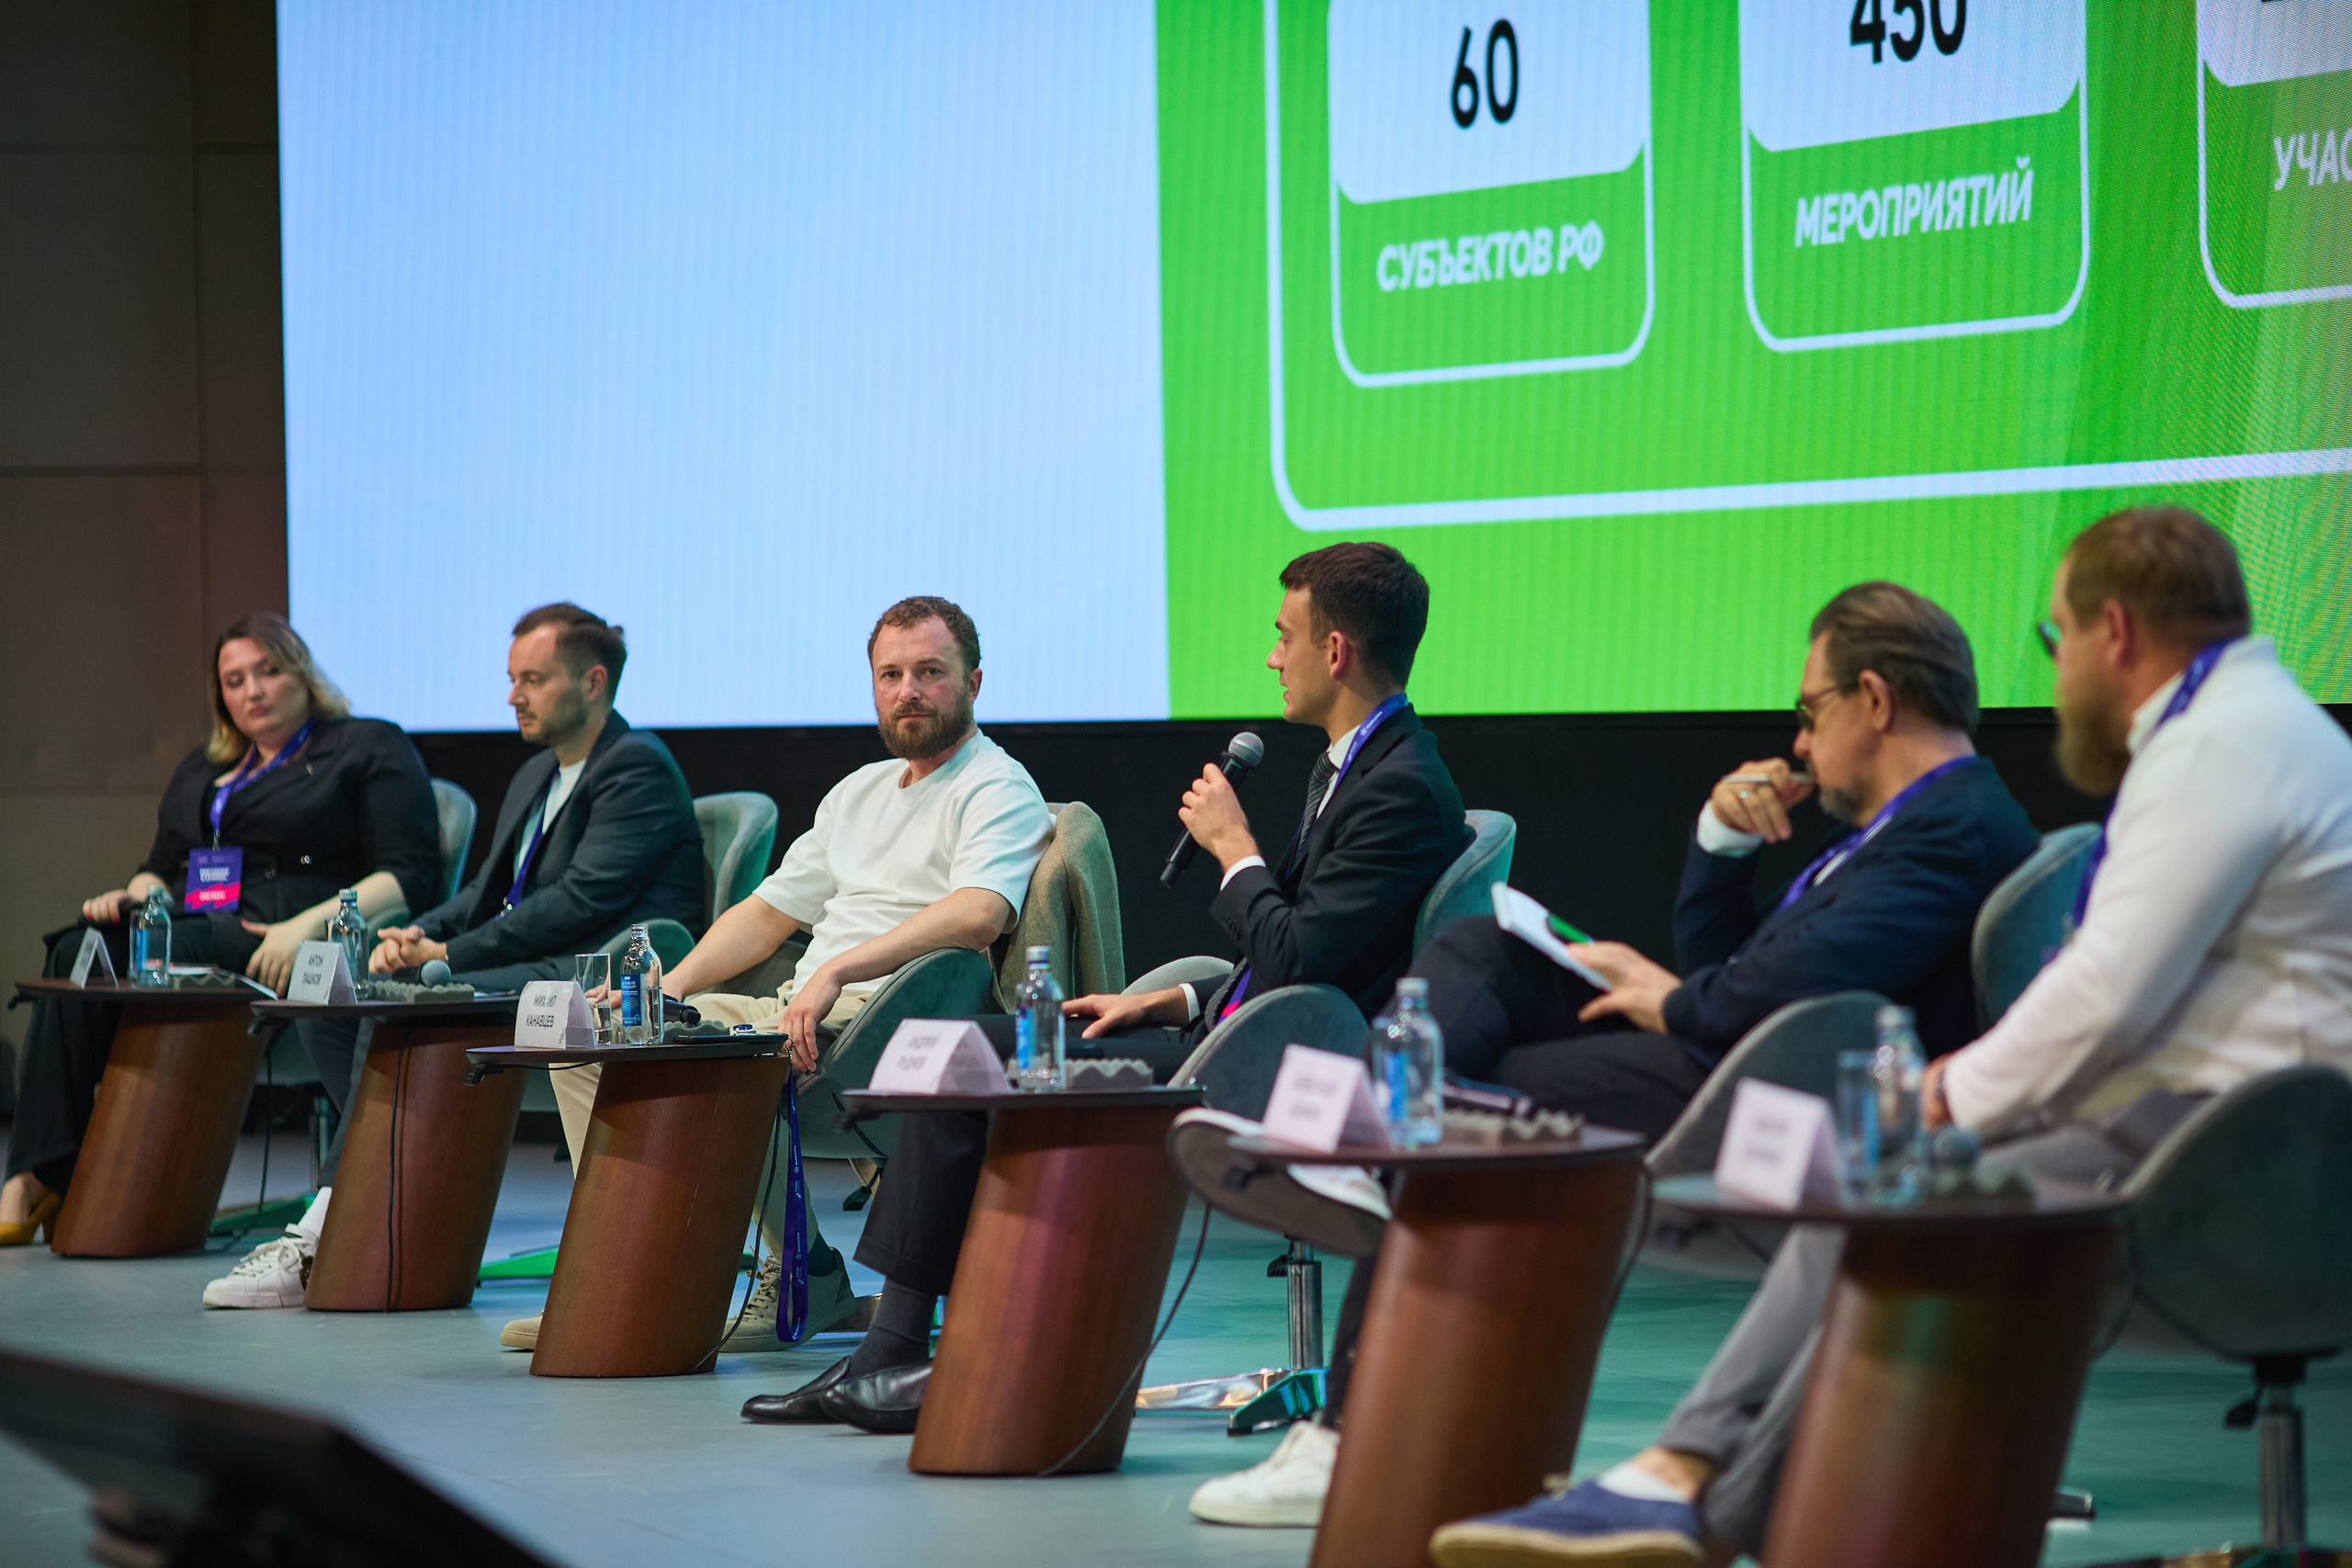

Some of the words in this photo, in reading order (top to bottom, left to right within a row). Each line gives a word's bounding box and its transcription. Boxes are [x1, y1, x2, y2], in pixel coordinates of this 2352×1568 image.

[1451, 17, 1520, 130] 60
[1794, 154, 2034, 248] МЕРОПРИЯТИЙ
[1376, 226, 1554, 292] СУБЪЕКТОВ
[1557, 220, 1604, 273] РФ
[526, 1014, 554, 1030] КАНАВЦЕВ
